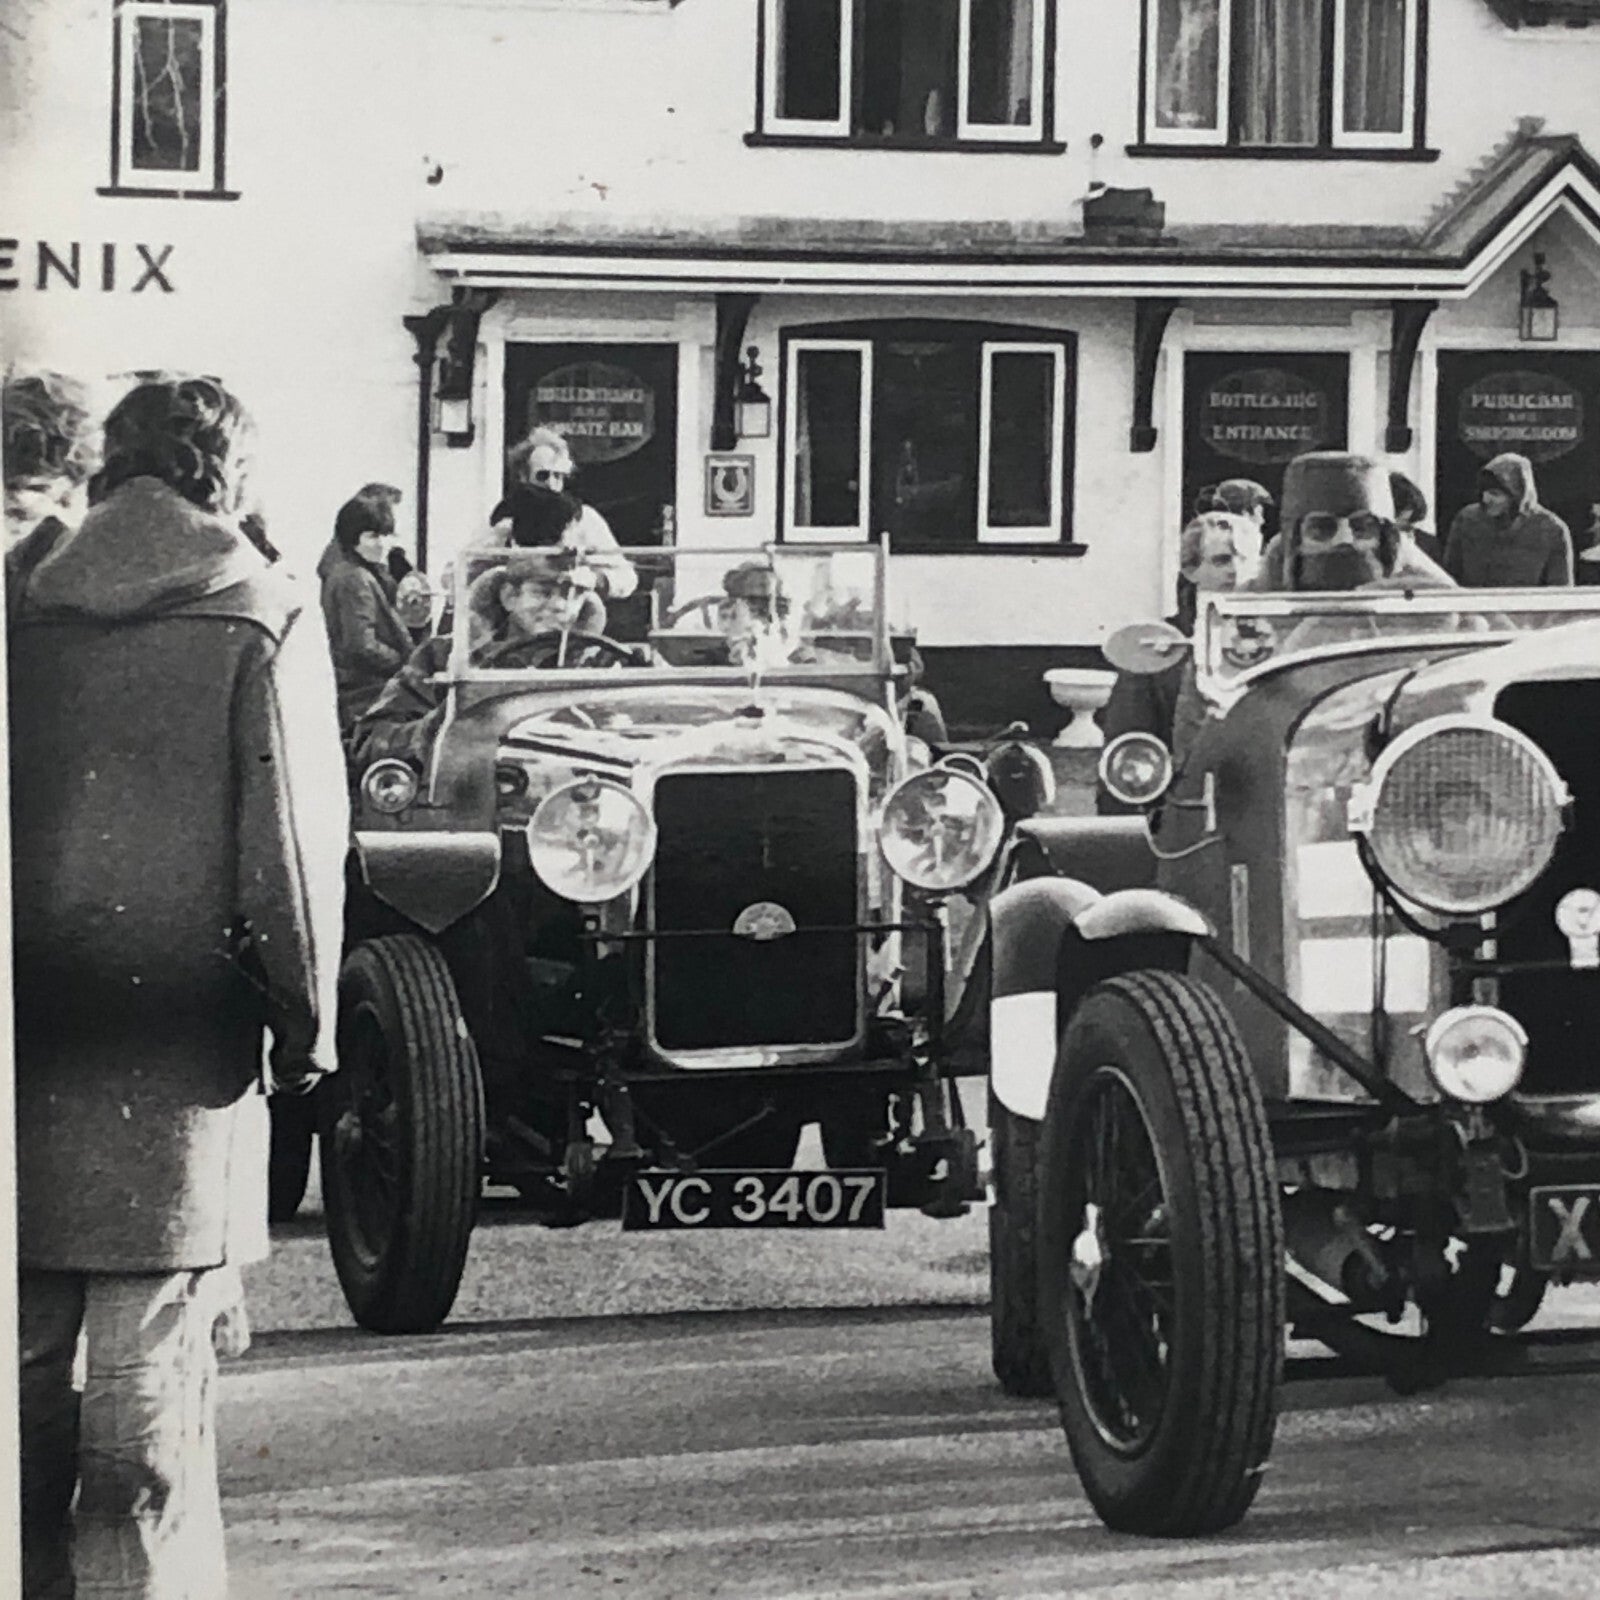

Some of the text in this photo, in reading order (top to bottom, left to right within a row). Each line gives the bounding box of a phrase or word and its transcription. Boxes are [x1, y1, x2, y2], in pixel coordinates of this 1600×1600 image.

[0, 238, 175, 292] ENIX
[1472, 394, 1535, 408] PUBLIC
[1212, 425, 1312, 440] ENTRANCE
[637, 1175, 876, 1224] YC 3407
[1548, 1196, 1600, 1262] X
